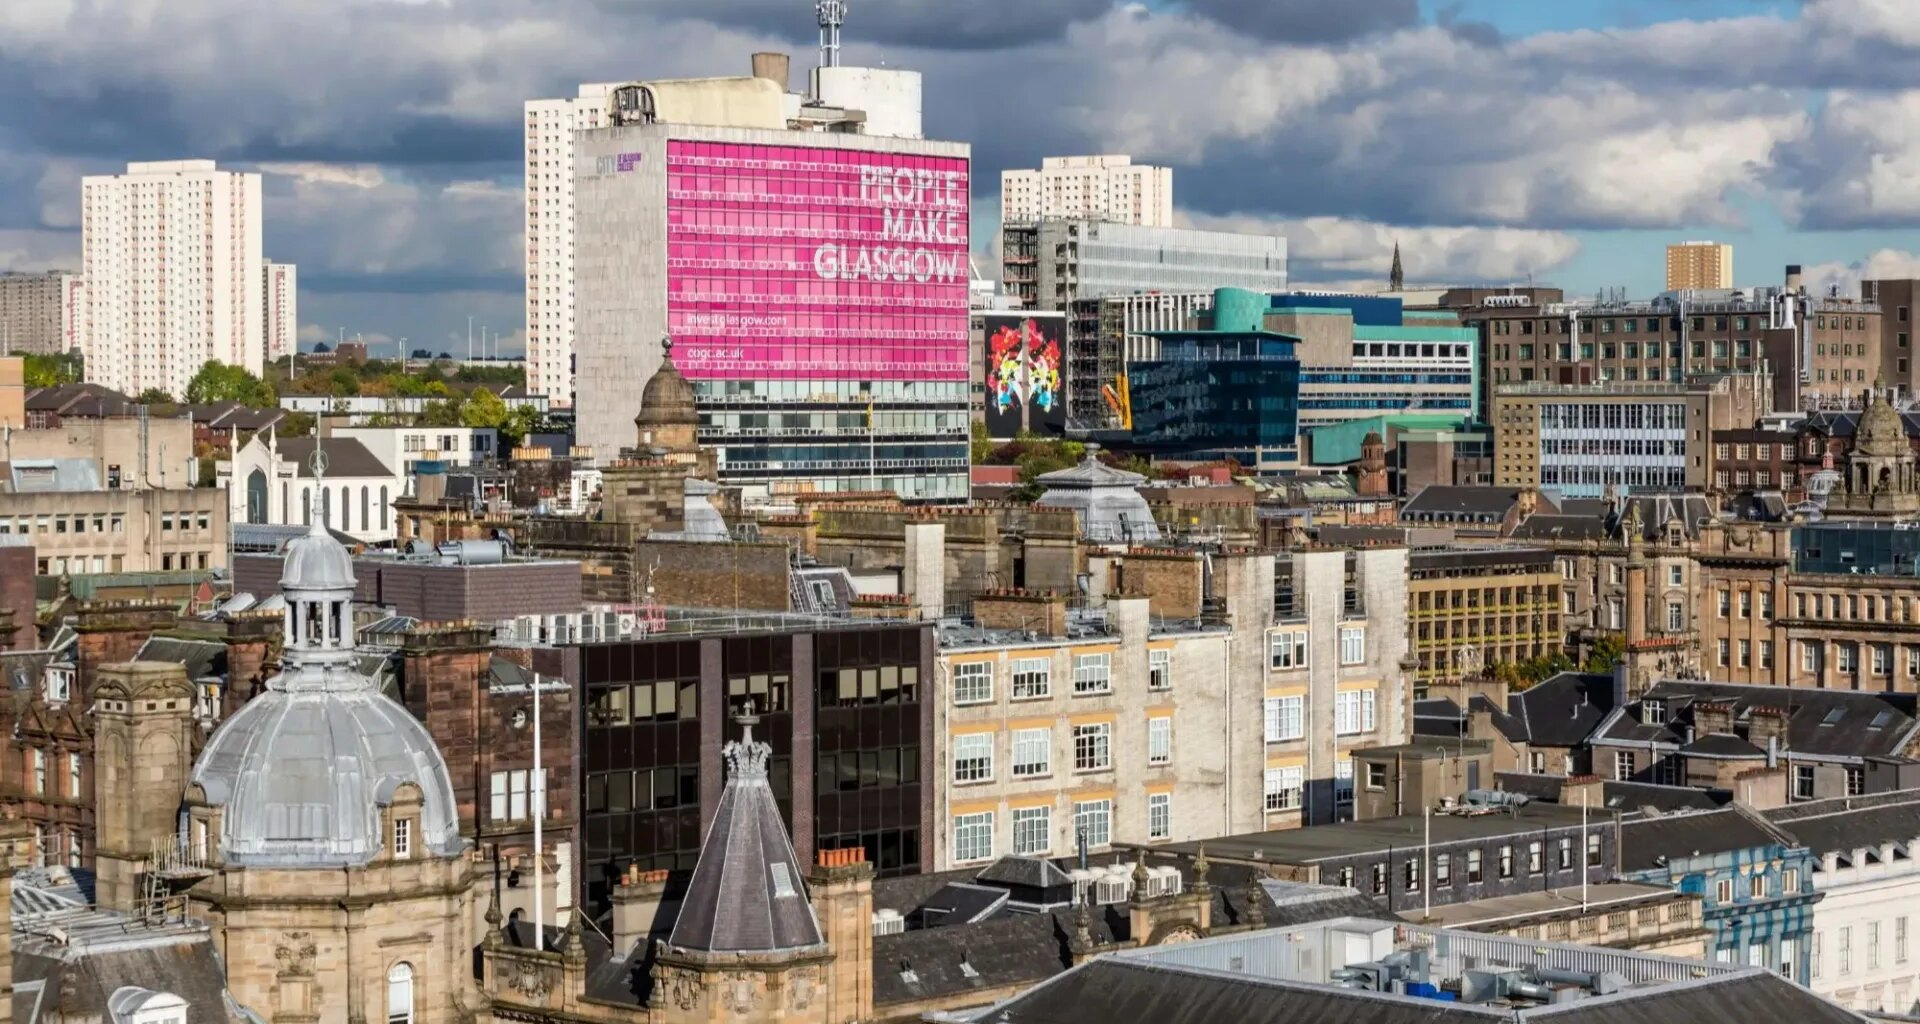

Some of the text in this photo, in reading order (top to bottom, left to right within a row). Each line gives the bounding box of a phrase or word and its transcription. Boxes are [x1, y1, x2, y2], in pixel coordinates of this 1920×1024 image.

[860, 164, 960, 206] PEOPLE
[883, 207, 960, 244] MAKE
[813, 242, 960, 284] GLASGOW
[687, 313, 788, 328] investglasgow.com
[687, 347, 744, 361] cogc.ac.uk
